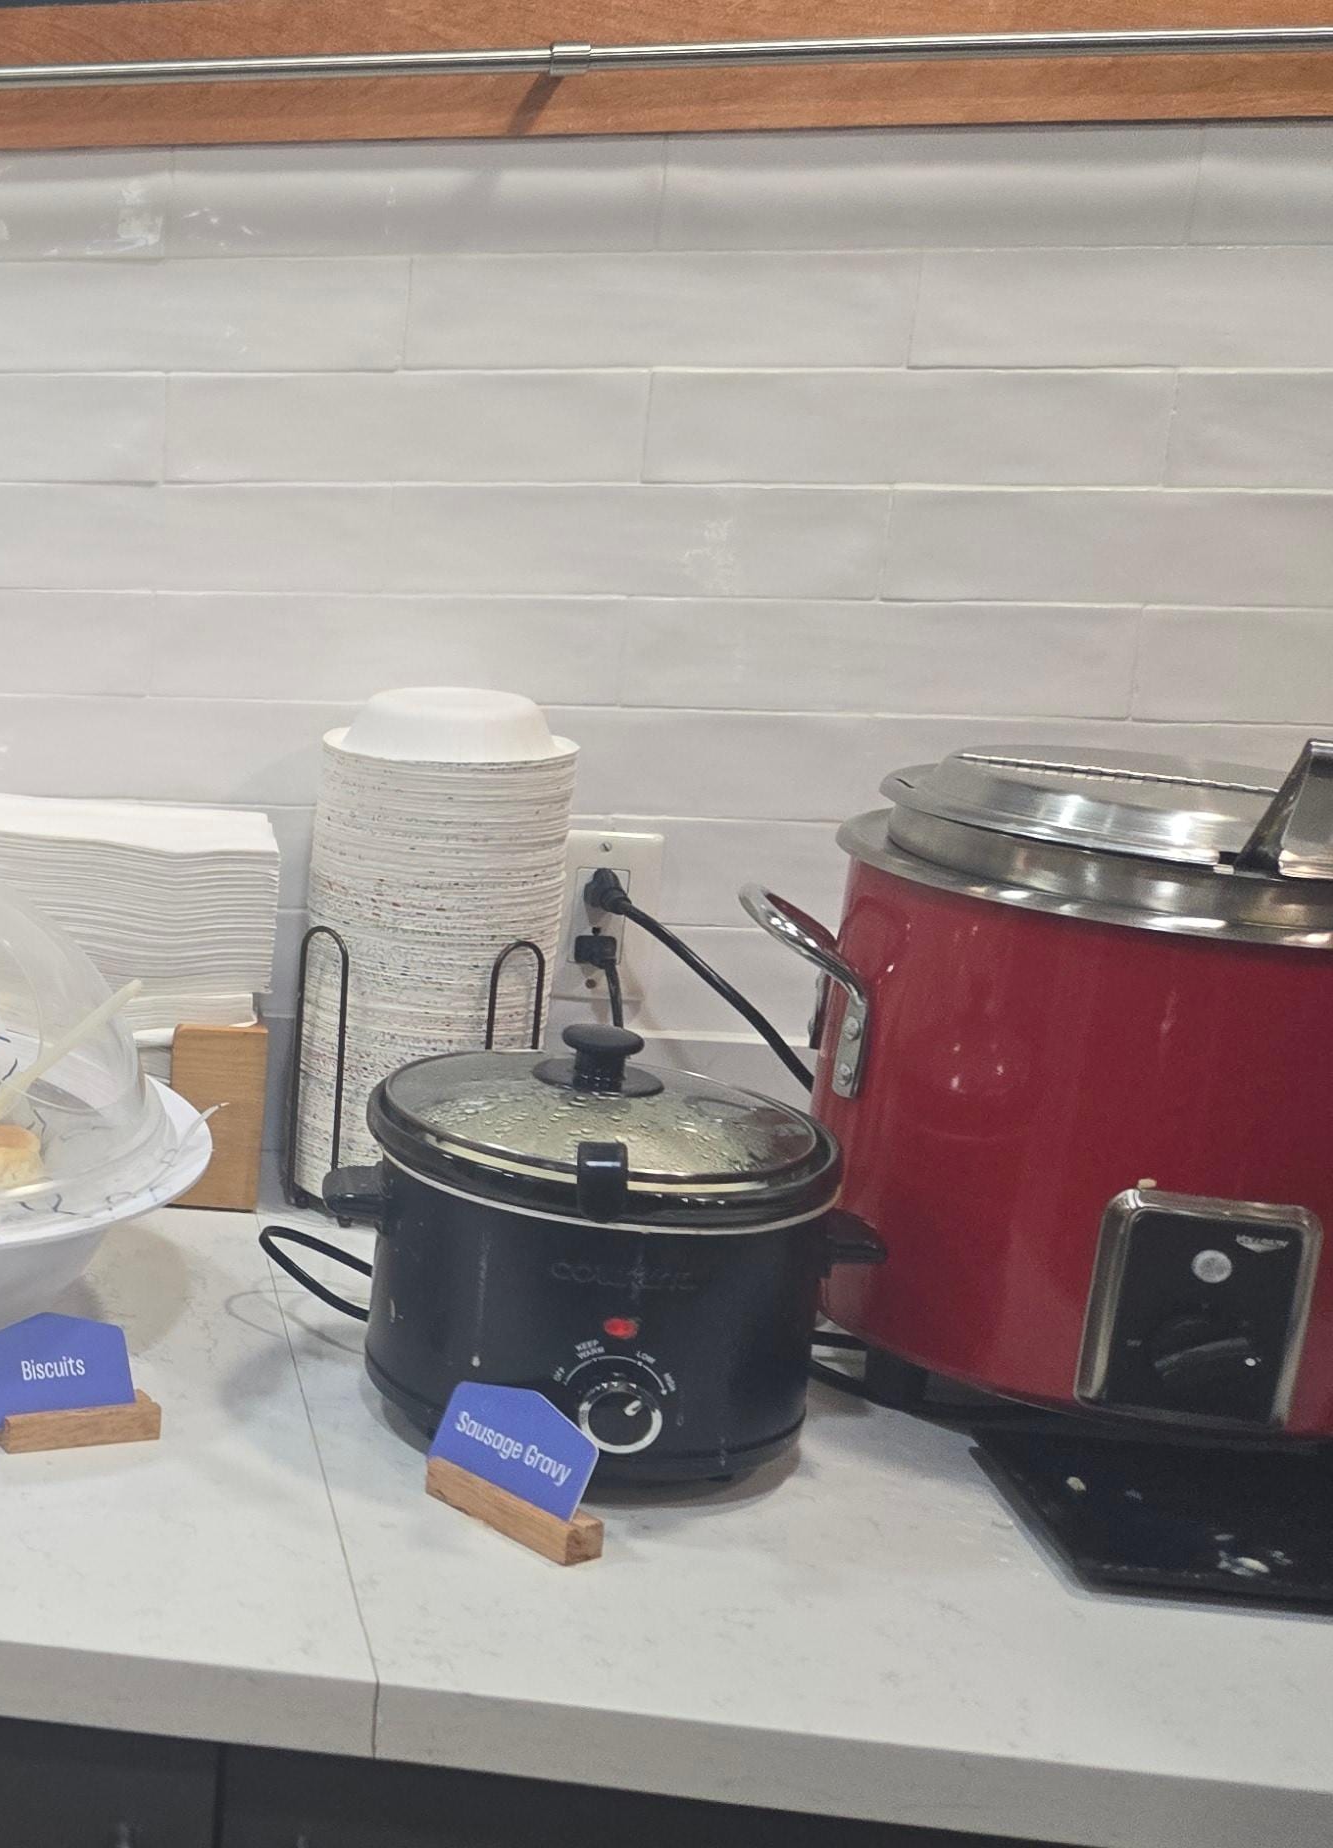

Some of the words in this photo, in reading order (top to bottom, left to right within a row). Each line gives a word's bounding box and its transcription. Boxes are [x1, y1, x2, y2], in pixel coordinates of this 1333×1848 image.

[21, 1356, 86, 1381] Biscuits
[455, 1411, 523, 1460] Sausage
[524, 1444, 572, 1487] Gravy
